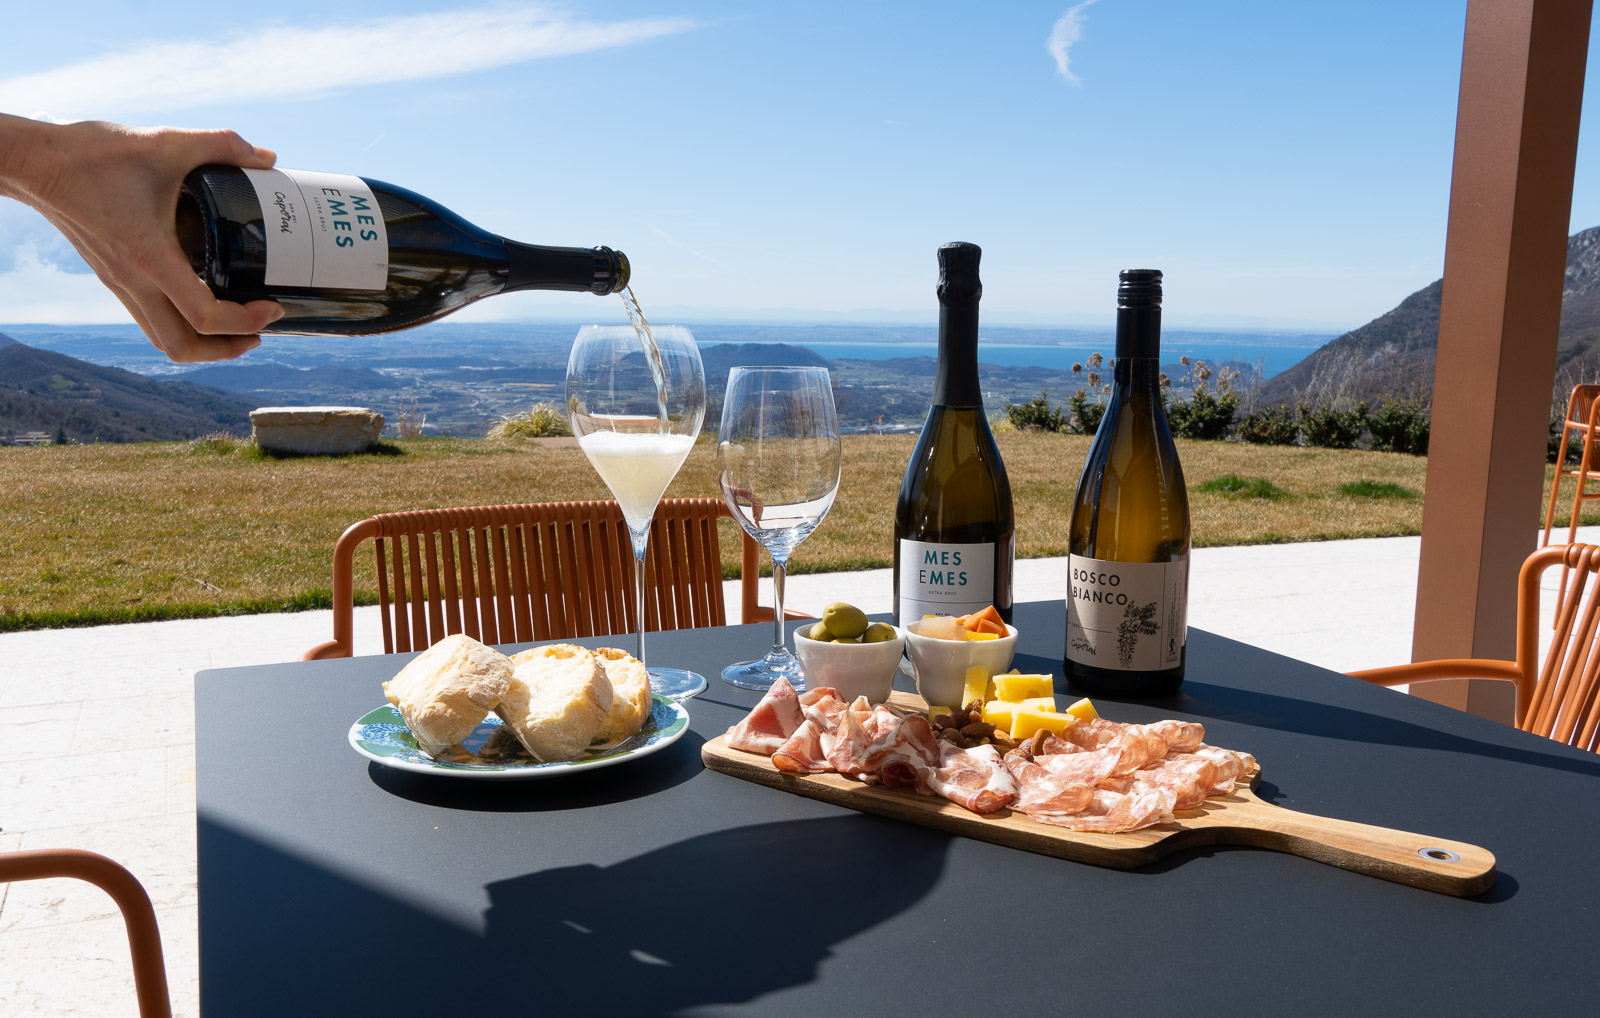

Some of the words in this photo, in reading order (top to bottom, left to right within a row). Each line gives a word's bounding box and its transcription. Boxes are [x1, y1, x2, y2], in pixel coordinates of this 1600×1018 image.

[313, 196, 322, 214] EXTRA
[319, 216, 327, 232] BRUT
[321, 187, 354, 248] EMES
[349, 194, 377, 241] MES
[924, 550, 962, 566] MES
[919, 569, 968, 586] EMES
[1073, 568, 1120, 587] BOSCO
[1073, 586, 1128, 606] BIANCO
